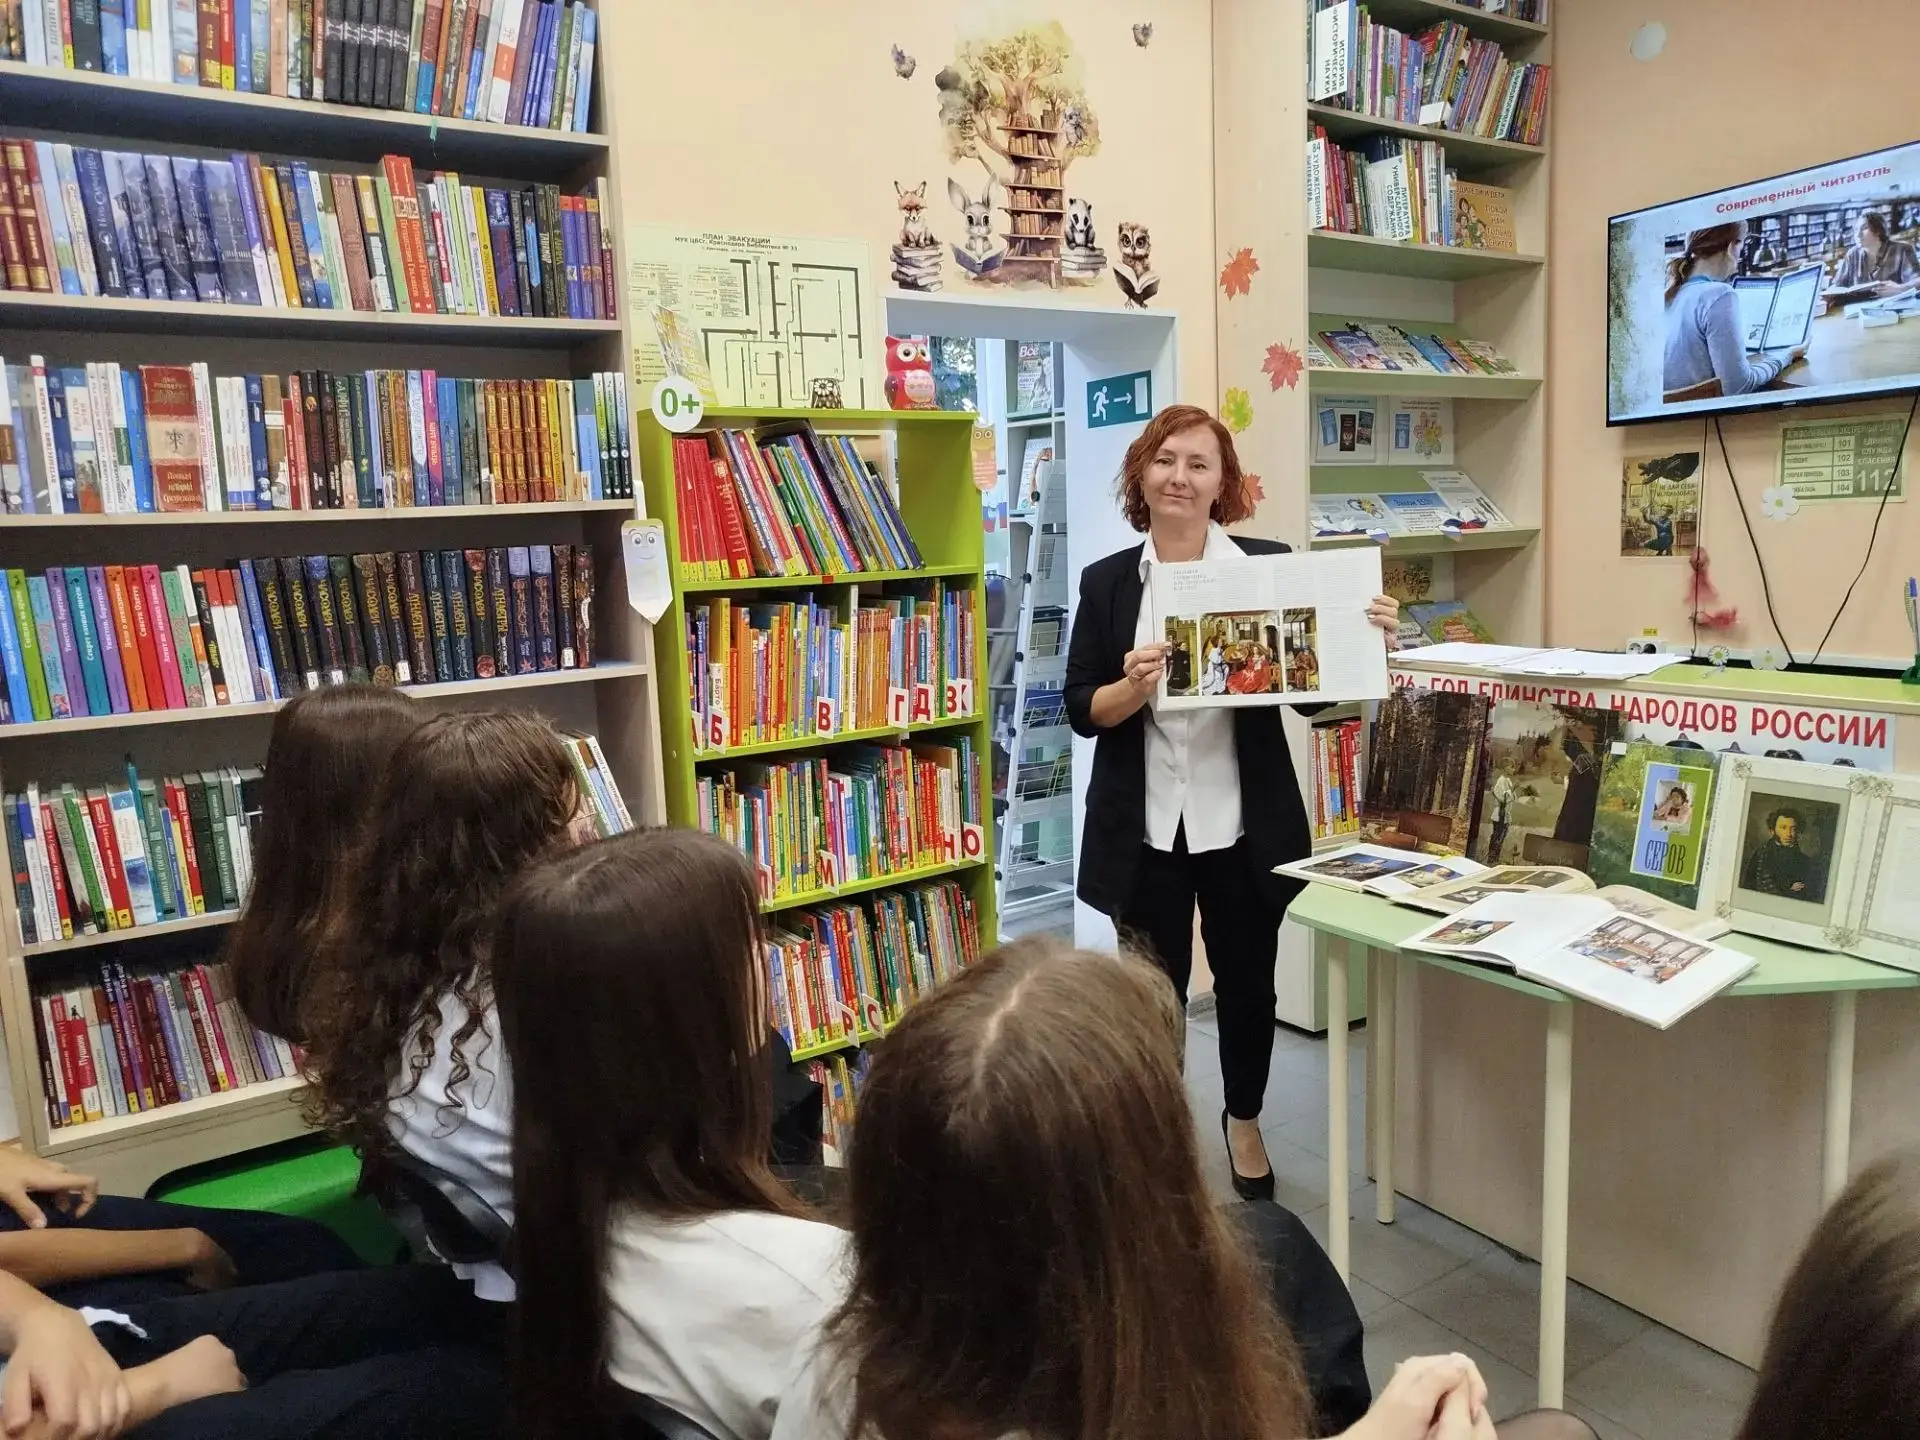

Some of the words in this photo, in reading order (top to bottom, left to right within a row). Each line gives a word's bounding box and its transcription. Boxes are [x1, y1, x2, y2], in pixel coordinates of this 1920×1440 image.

[1331, 15, 1339, 93] ИСТОРИЧЕСКИЕ
[1323, 59, 1331, 95] НАУКИ
[1312, 152, 1322, 226] ХУДОЖЕСТВЕННАЯ
[1392, 164, 1404, 238] УНИВЕРСАЛЬНОГО
[1716, 182, 1816, 214] Современный
[1820, 165, 1892, 189] читатель
[1386, 185, 1397, 239] СОДЕРЖАНИЯ
[1400, 186, 1411, 236] ЛИТЕРАТУРА
[702, 233, 723, 241] ПЛАН
[727, 235, 771, 245] ЭВАКУАЦИИ
[660, 388, 700, 417] 0+
[1837, 454, 1851, 463] 102
[1838, 439, 1852, 448] 101
[1837, 470, 1850, 478] 103
[1857, 468, 1897, 492] 112
[266, 582, 282, 629] ЧАСОДЕИ
[292, 581, 308, 628] ЧАСОДЕИ
[318, 579, 333, 626] ЧАСОДЕИ
[340, 579, 354, 624] ЧАСОДЕИ
[366, 578, 380, 625] ЧАСОДЕИ
[386, 574, 398, 620] ЧАСОДЕИ
[474, 571, 485, 616] ЧАСОДЕИ
[62, 623, 72, 652] Уинстон,
[137, 612, 146, 636] Спасти
[84, 637, 94, 660] Секрет
[817, 701, 831, 732] В
[895, 694, 905, 722] Г
[913, 687, 931, 721] Д
[1479, 682, 1597, 709] ЕДИНСТВА
[1610, 695, 1738, 733] НАРОДОВ
[1751, 707, 1886, 749] РОССИИ
[710, 717, 723, 746] Б
[943, 833, 955, 860] Н
[963, 828, 980, 856] О
[1644, 839, 1687, 875] СЕРОВ
[820, 857, 835, 887] М
[842, 1010, 854, 1031] Р
[866, 1003, 881, 1032] С
[77, 1035, 87, 1066] Пушкин
